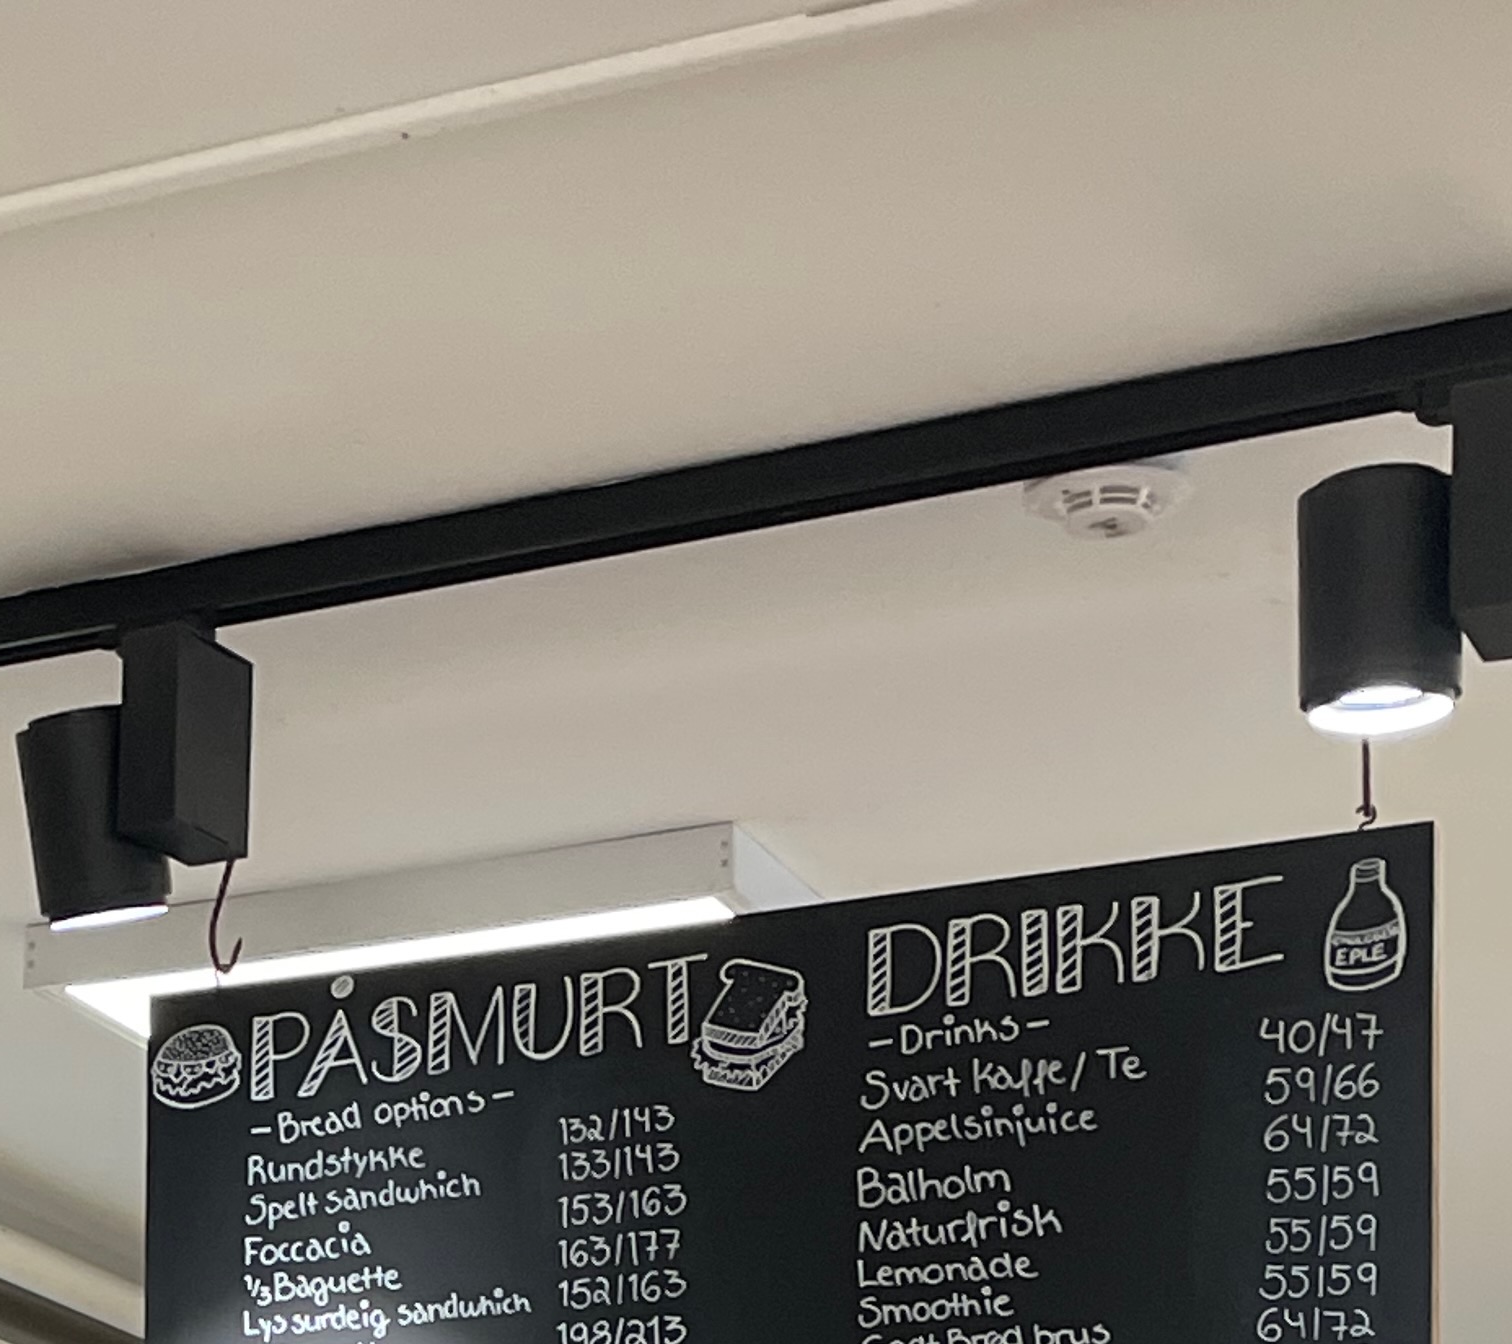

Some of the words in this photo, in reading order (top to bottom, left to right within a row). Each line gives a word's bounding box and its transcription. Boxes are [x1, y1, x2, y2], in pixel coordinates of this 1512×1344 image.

[867, 875, 1284, 1017] DRIKKE
[1334, 942, 1387, 967] EPLE
[250, 953, 708, 1103] PÅSMURT
[1259, 1012, 1384, 1057] 40/47
[860, 1067, 961, 1110] Svart
[1096, 1046, 1147, 1079] Te
[1264, 1062, 1380, 1106] 59/66
[558, 1105, 675, 1145] 132/143
[859, 1102, 1098, 1155] Appelsinjuice
[1263, 1113, 1380, 1153] 64/72
[247, 1146, 426, 1186] Rundstykke
[558, 1143, 680, 1181] 133/143
[1266, 1161, 1380, 1205] 55/59
[244, 1191, 319, 1231] Spelt
[324, 1170, 481, 1215] sandwhich
[558, 1184, 687, 1229] 153/163
[857, 1165, 1011, 1208] Balholm
[244, 1220, 372, 1266] Foccacia
[858, 1200, 1063, 1252] Naturfrisk
[1265, 1213, 1378, 1257] 55/59
[558, 1229, 680, 1269] 163/177
[857, 1252, 1038, 1287] Lemonade
[558, 1270, 687, 1310] 152/163
[1258, 1262, 1377, 1300] 55/59
[291, 1299, 390, 1339] surdeig
[397, 1287, 532, 1327] sandwhich
[858, 1285, 1014, 1328] Smoothie
[1257, 1306, 1376, 1342] 64/72
